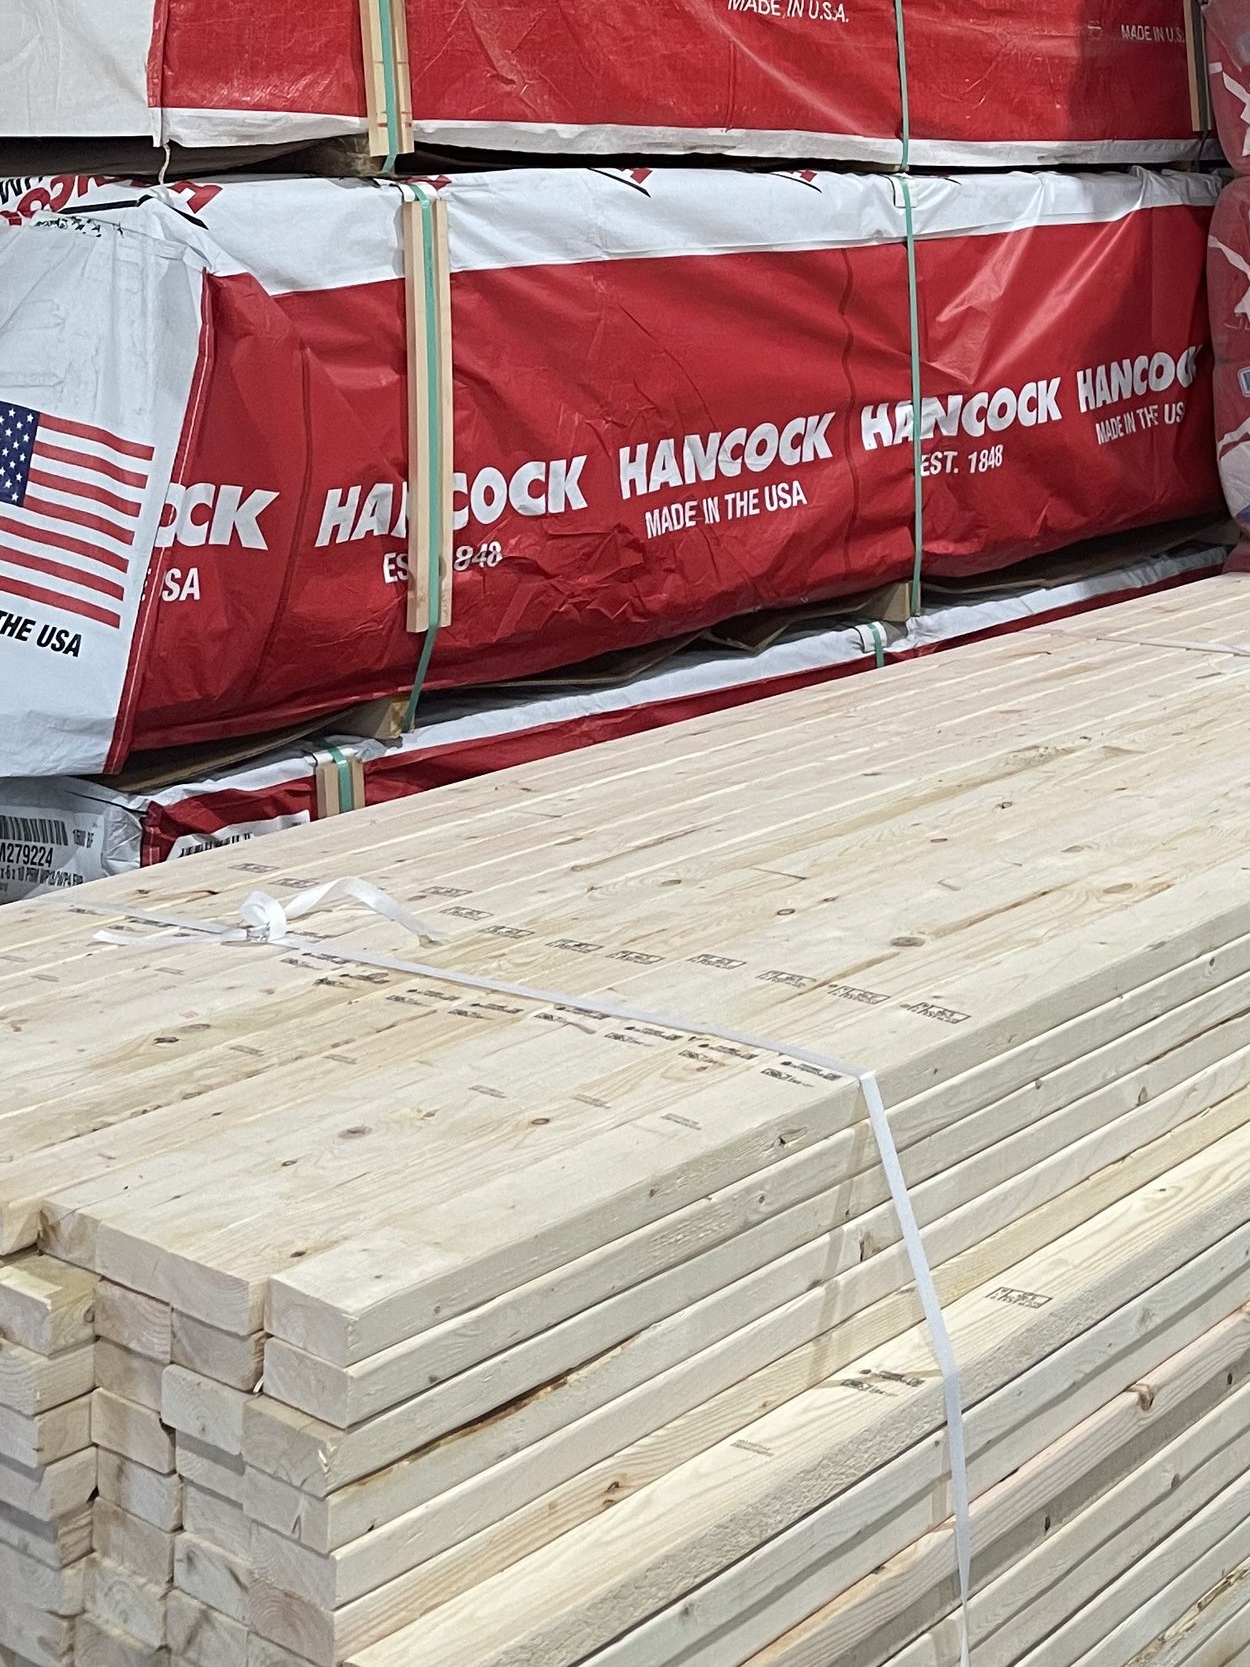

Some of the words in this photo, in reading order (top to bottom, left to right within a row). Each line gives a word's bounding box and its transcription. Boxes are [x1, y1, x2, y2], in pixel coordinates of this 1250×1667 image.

[808, 0, 850, 24] U.S.A.
[1120, 23, 1151, 43] MADE
[1152, 25, 1164, 43] IN
[859, 375, 1062, 452] HANCOCK
[1094, 415, 1123, 446] MADE
[1125, 412, 1136, 436] IN
[1137, 403, 1159, 432] THE
[618, 410, 837, 501] HANCOCK
[918, 450, 960, 478] EST.
[967, 444, 1004, 474] 1848
[644, 499, 697, 541] MADE
[701, 492, 721, 526] IN
[723, 486, 760, 521] THE
[763, 480, 808, 512] USA
[36, 624, 82, 660] USA
